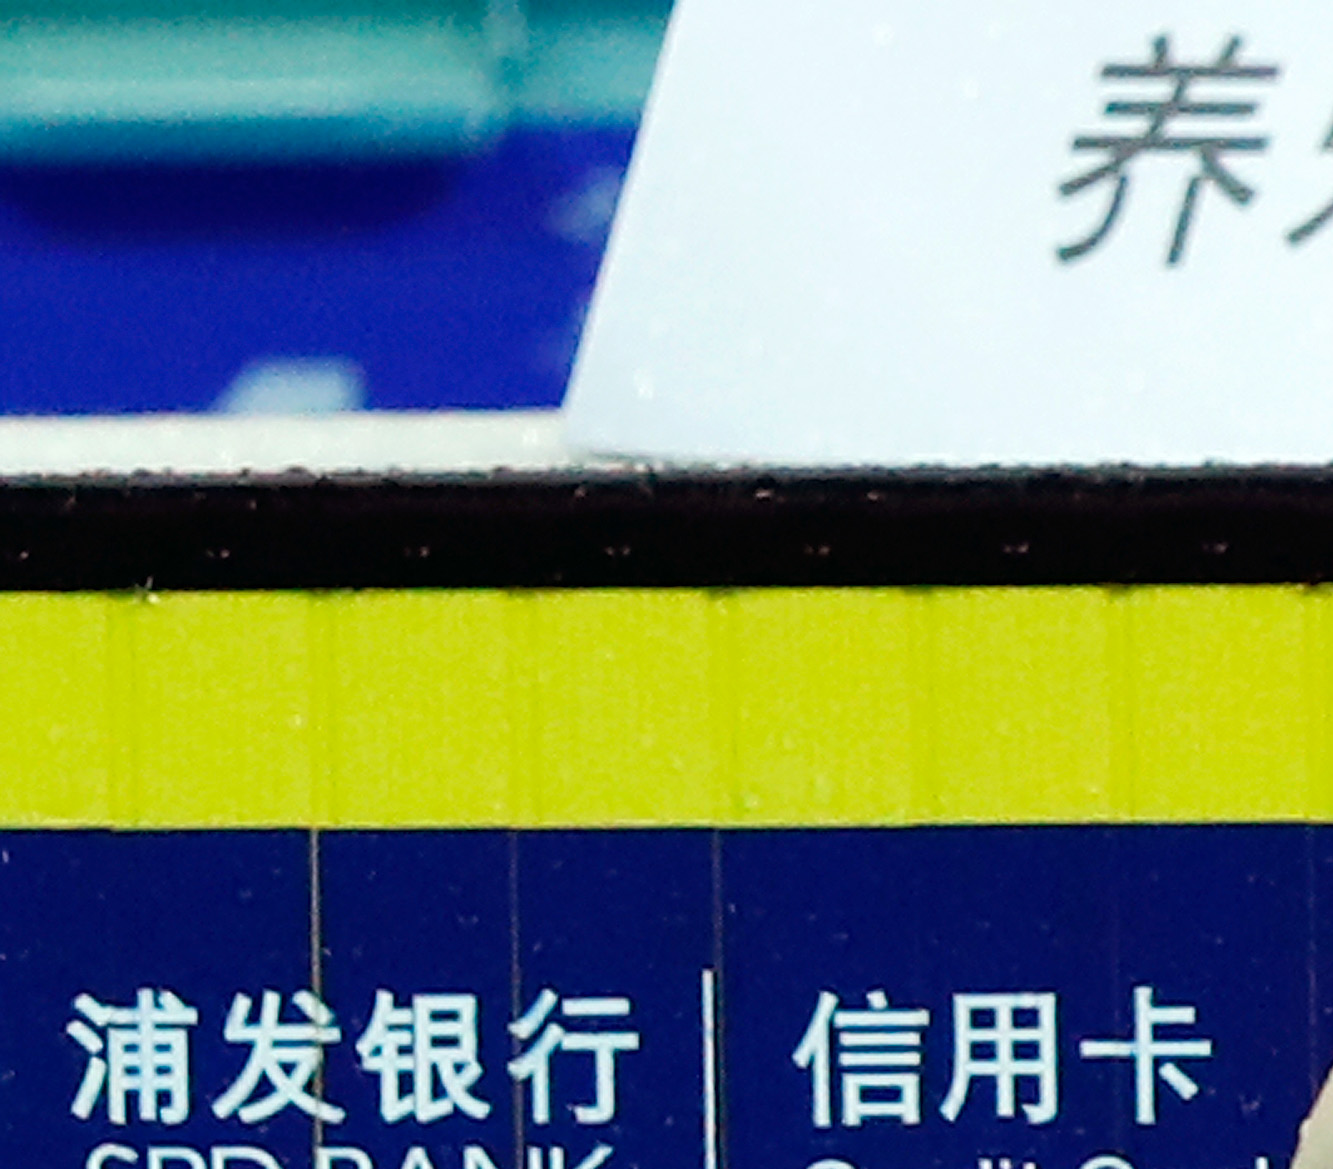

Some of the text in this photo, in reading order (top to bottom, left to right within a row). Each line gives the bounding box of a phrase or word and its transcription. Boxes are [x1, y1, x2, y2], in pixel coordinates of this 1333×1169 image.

[66, 987, 640, 1126] 浦发银行
[792, 986, 1213, 1127] 信用卡
